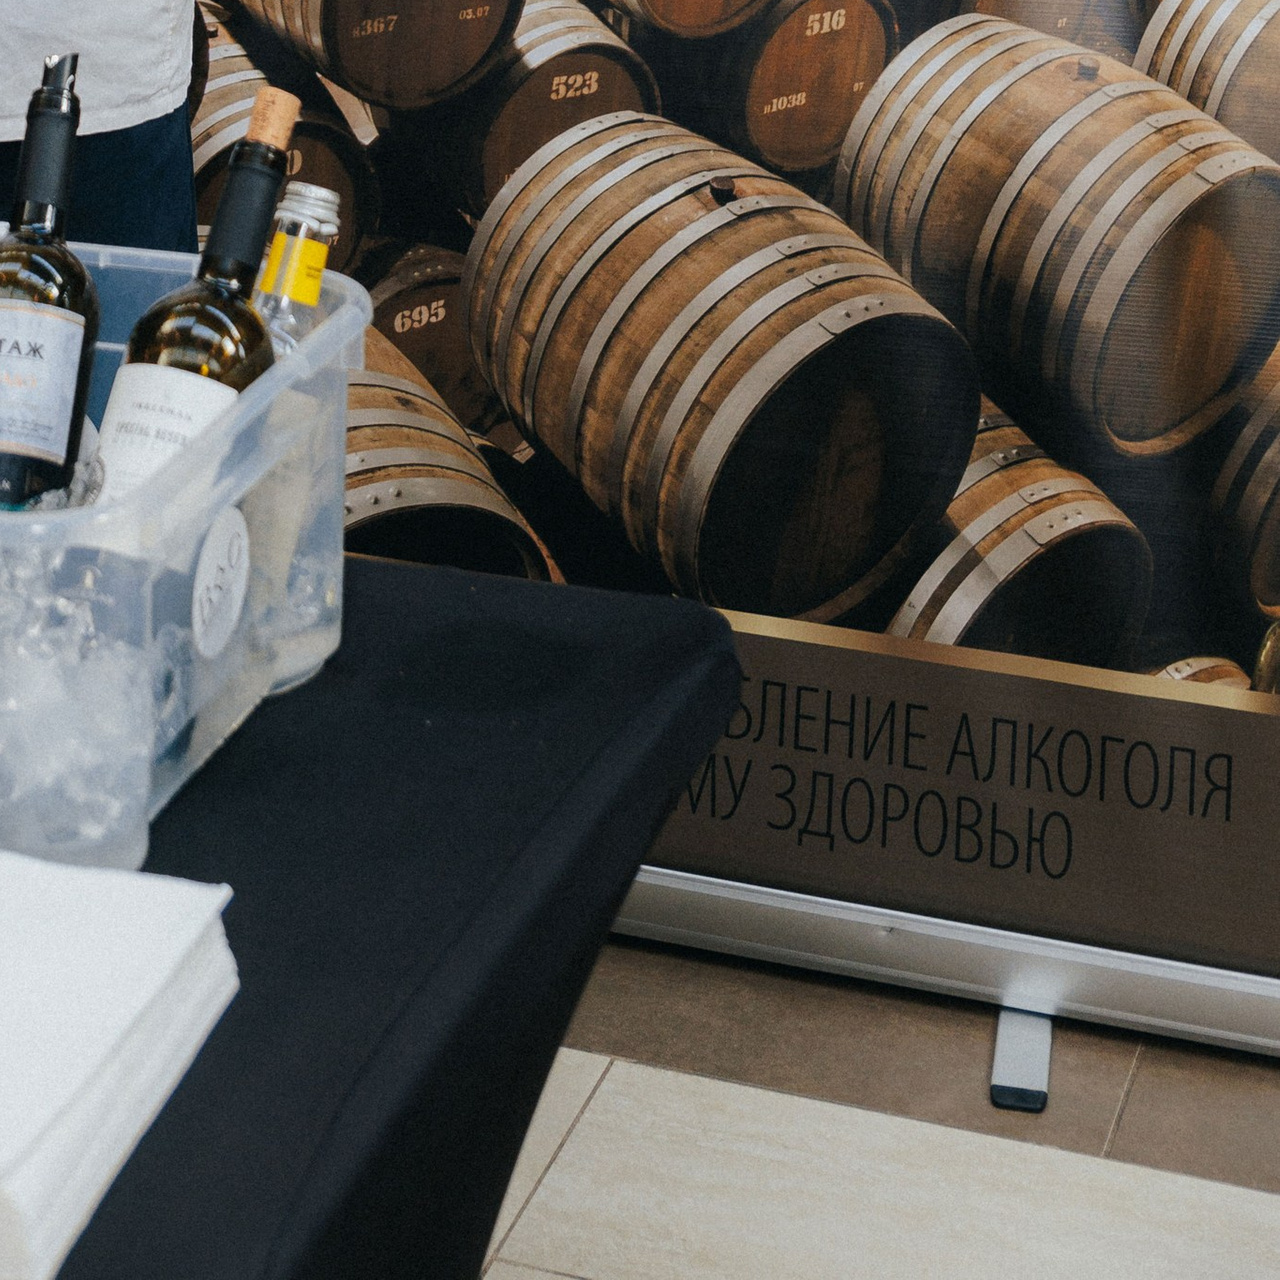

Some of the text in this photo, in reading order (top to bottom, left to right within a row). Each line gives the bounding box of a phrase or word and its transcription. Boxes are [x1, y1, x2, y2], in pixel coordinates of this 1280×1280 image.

[805, 8, 847, 37] 516
[549, 70, 600, 101] 523
[394, 299, 446, 333] 695
[945, 711, 1234, 823] АЛКОГОЛЯ
[766, 763, 1073, 880] ЗДОРОВЬЮ
